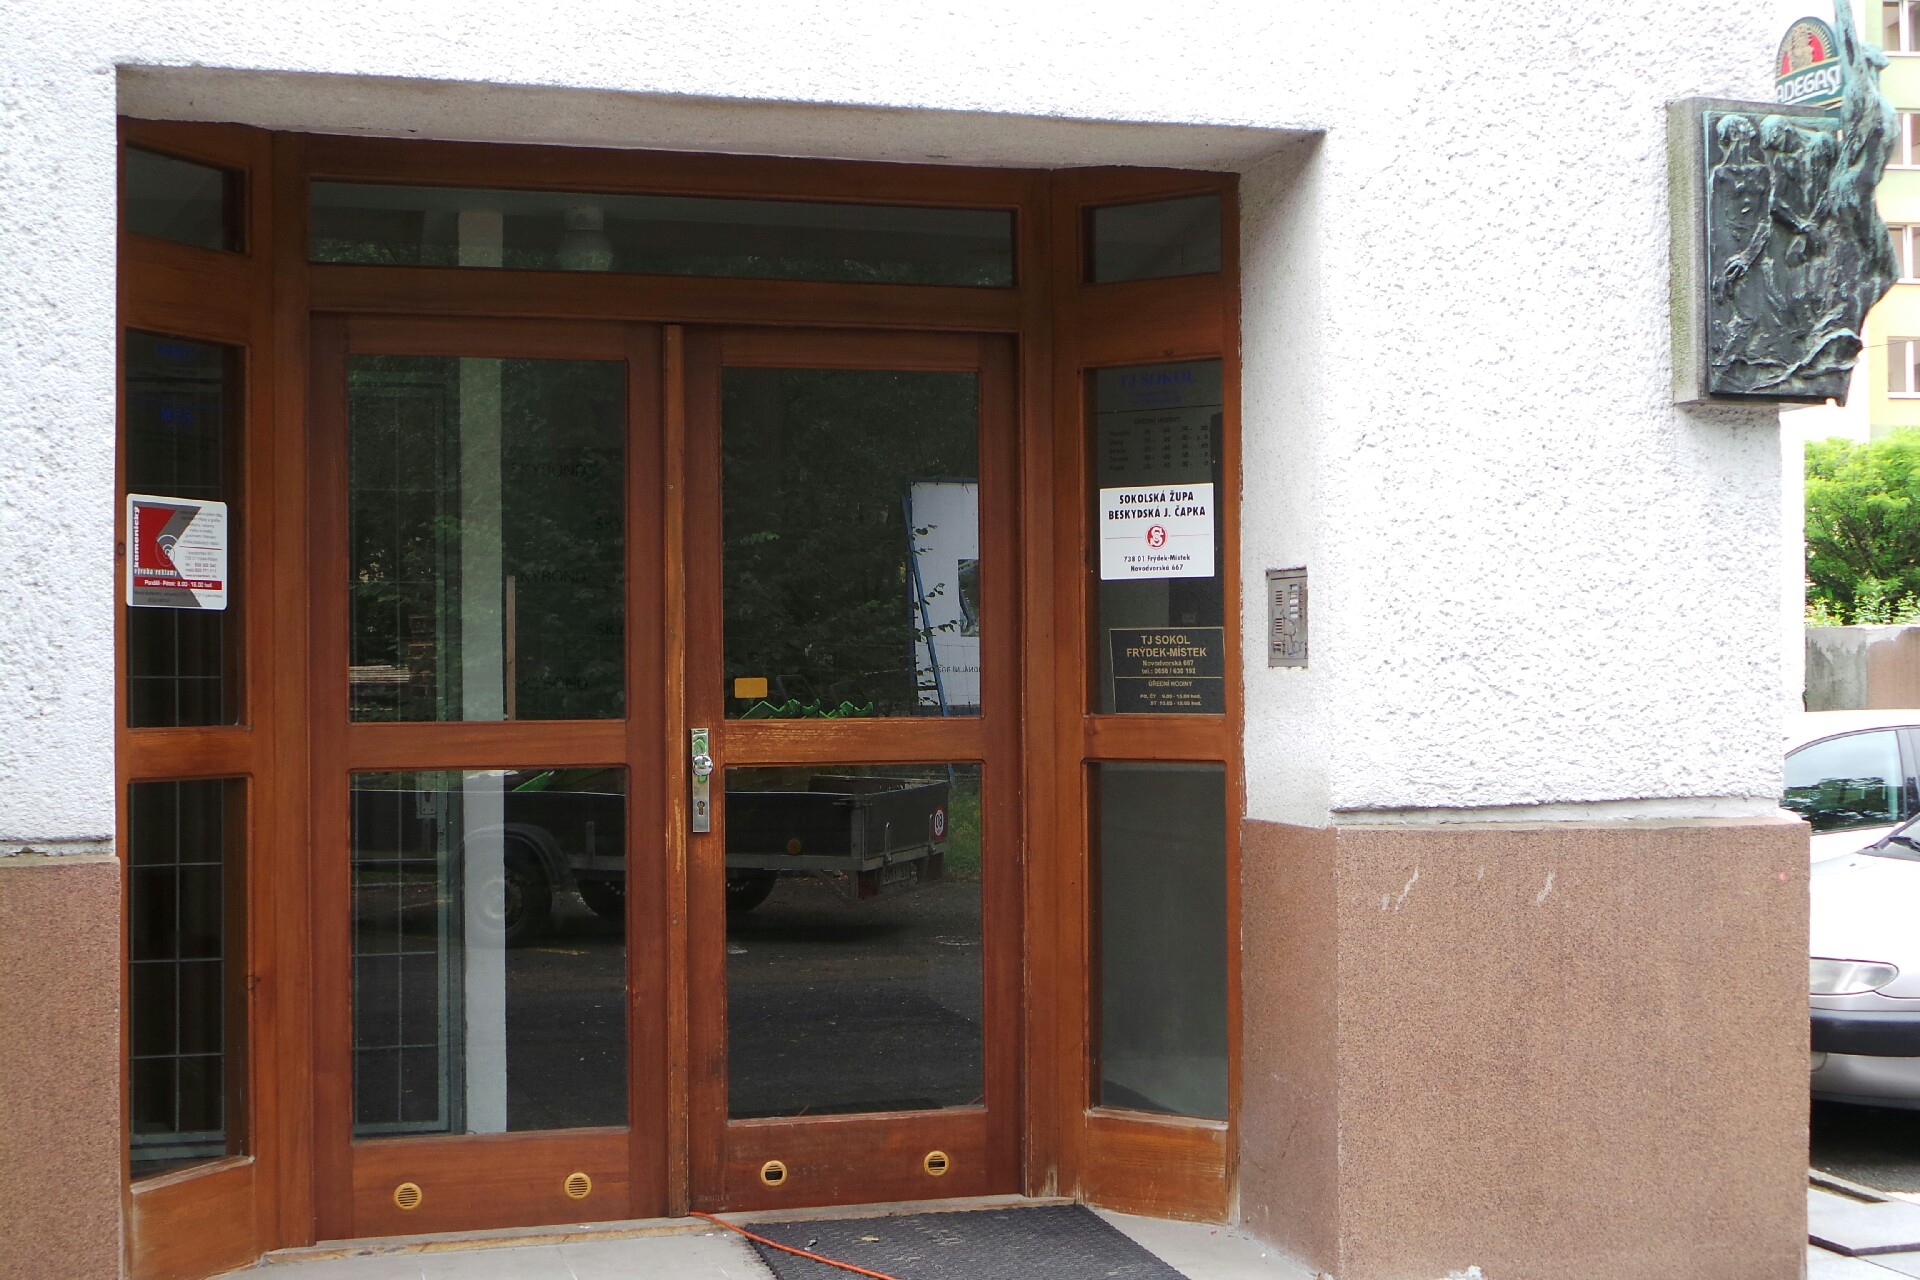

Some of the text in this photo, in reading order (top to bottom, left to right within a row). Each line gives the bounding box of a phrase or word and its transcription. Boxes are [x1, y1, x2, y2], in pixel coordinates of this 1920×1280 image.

[1119, 489, 1194, 504] SOKOLSKÁ ŽUPA
[1108, 504, 1206, 520] BESKYDSKÁ J. ČAPKA
[1124, 555, 1135, 563] 738
[1147, 553, 1191, 563] Frýdek-Místek
[155, 569, 177, 577] reklamy
[1130, 564, 1170, 572] Novodvorská
[1140, 634, 1191, 645] TJ SOKOL
[1126, 645, 1207, 657] FRÝDEK-MÍSTEK
[1142, 659, 1182, 667] Novodvorská
